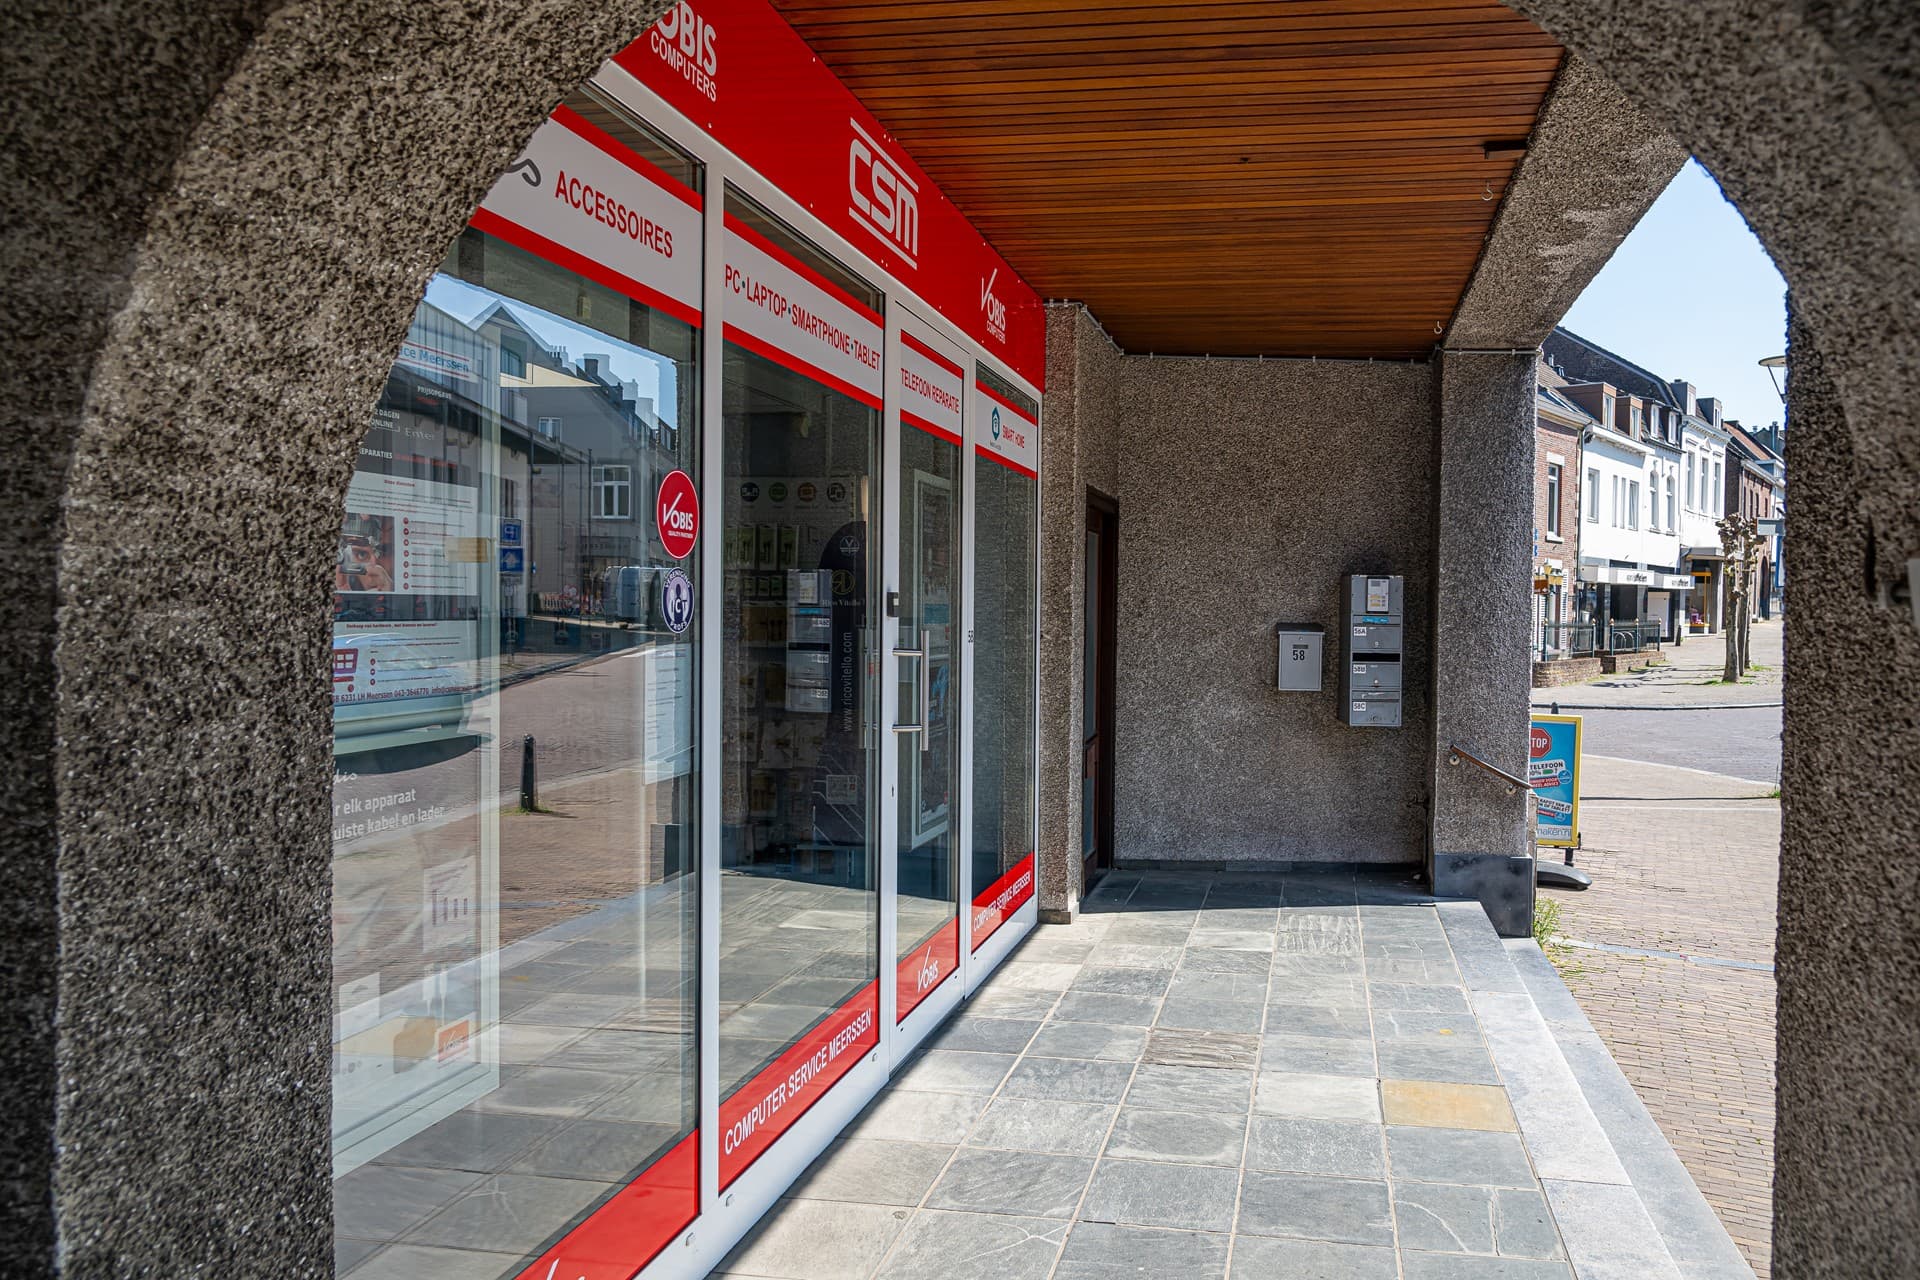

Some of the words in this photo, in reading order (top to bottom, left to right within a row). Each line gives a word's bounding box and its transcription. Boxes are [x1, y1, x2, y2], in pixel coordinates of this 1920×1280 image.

[656, 0, 717, 76] OBIS
[651, 30, 717, 102] COMPUTERS
[555, 170, 673, 258] ACCESSOIRES
[849, 138, 919, 257] CSM
[725, 264, 741, 294] PC
[746, 277, 787, 319] LAPTOP
[792, 303, 850, 355] SMARTPHONE
[853, 340, 881, 371] TABLET
[981, 267, 1006, 332] VOBIS
[420, 350, 469, 373] Meerssen
[900, 367, 931, 399] TELEFOON
[931, 385, 960, 414] REPARATIE
[379, 410, 400, 419] DAGEN
[663, 492, 694, 531] VOBIS
[671, 599, 688, 613] ICT
[1293, 649, 1305, 661] 58
[1531, 737, 1548, 748] TOP
[1530, 761, 1564, 770] TELEFOON
[343, 798, 362, 815] elk
[365, 788, 417, 812] apparaat
[333, 824, 364, 840] uiste
[368, 813, 399, 833] kabel
[402, 813, 415, 825] en
[974, 900, 997, 932] COMPUTER
[997, 886, 1013, 911] SERVICE
[1012, 870, 1031, 897] MEERSSEN
[725, 1082, 786, 1155] COMPUTER
[788, 1045, 827, 1098] SERVICE
[828, 1008, 871, 1063] MEERSSEN
